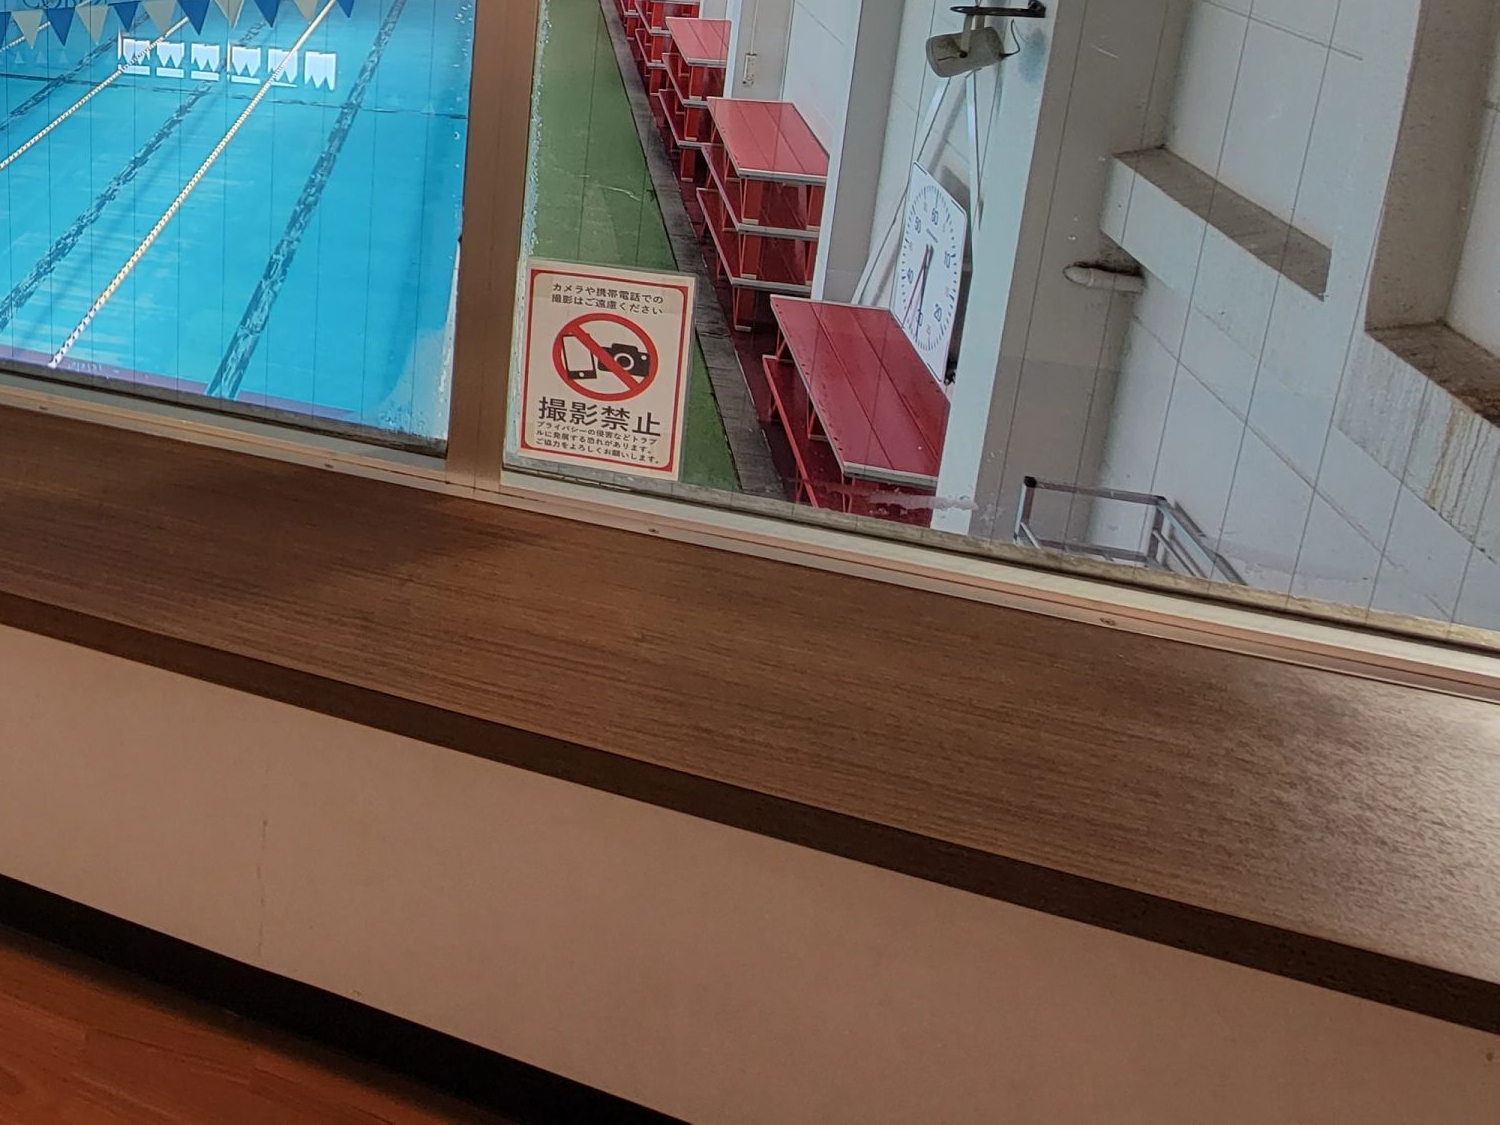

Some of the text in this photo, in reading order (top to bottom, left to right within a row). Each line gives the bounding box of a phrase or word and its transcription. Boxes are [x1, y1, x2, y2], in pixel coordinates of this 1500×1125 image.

[551, 294, 663, 315] 撮影はご遠慮ください
[552, 283, 664, 304] カメラや携帯電話での
[538, 396, 661, 436] 撮影禁止
[536, 430, 652, 454] ルに発展する恐れがあります。
[537, 421, 658, 445] プライバシーの侵害などトラブ
[535, 437, 659, 464] ご協力をよろしくお願いします。
